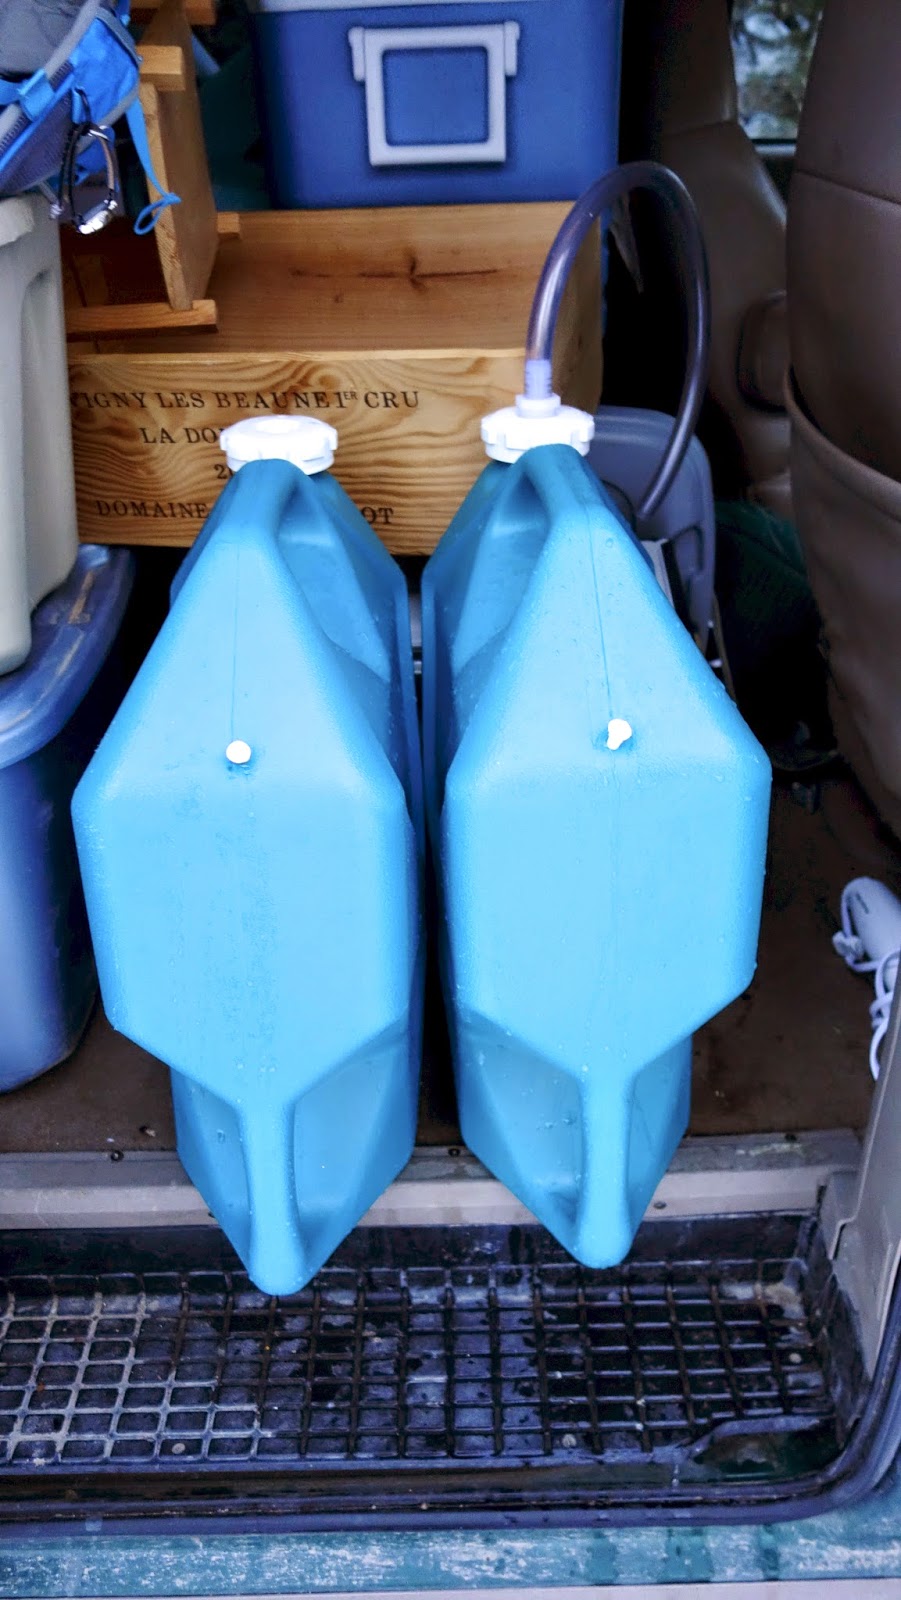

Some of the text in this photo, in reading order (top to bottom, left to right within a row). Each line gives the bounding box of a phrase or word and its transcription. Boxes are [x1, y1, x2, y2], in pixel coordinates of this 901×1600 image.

[155, 391, 205, 409] LES
[212, 391, 330, 409] BEAUNE
[364, 391, 419, 409] CRU
[139, 426, 224, 444] LA DO
[96, 500, 394, 525] DOMAINE OT
